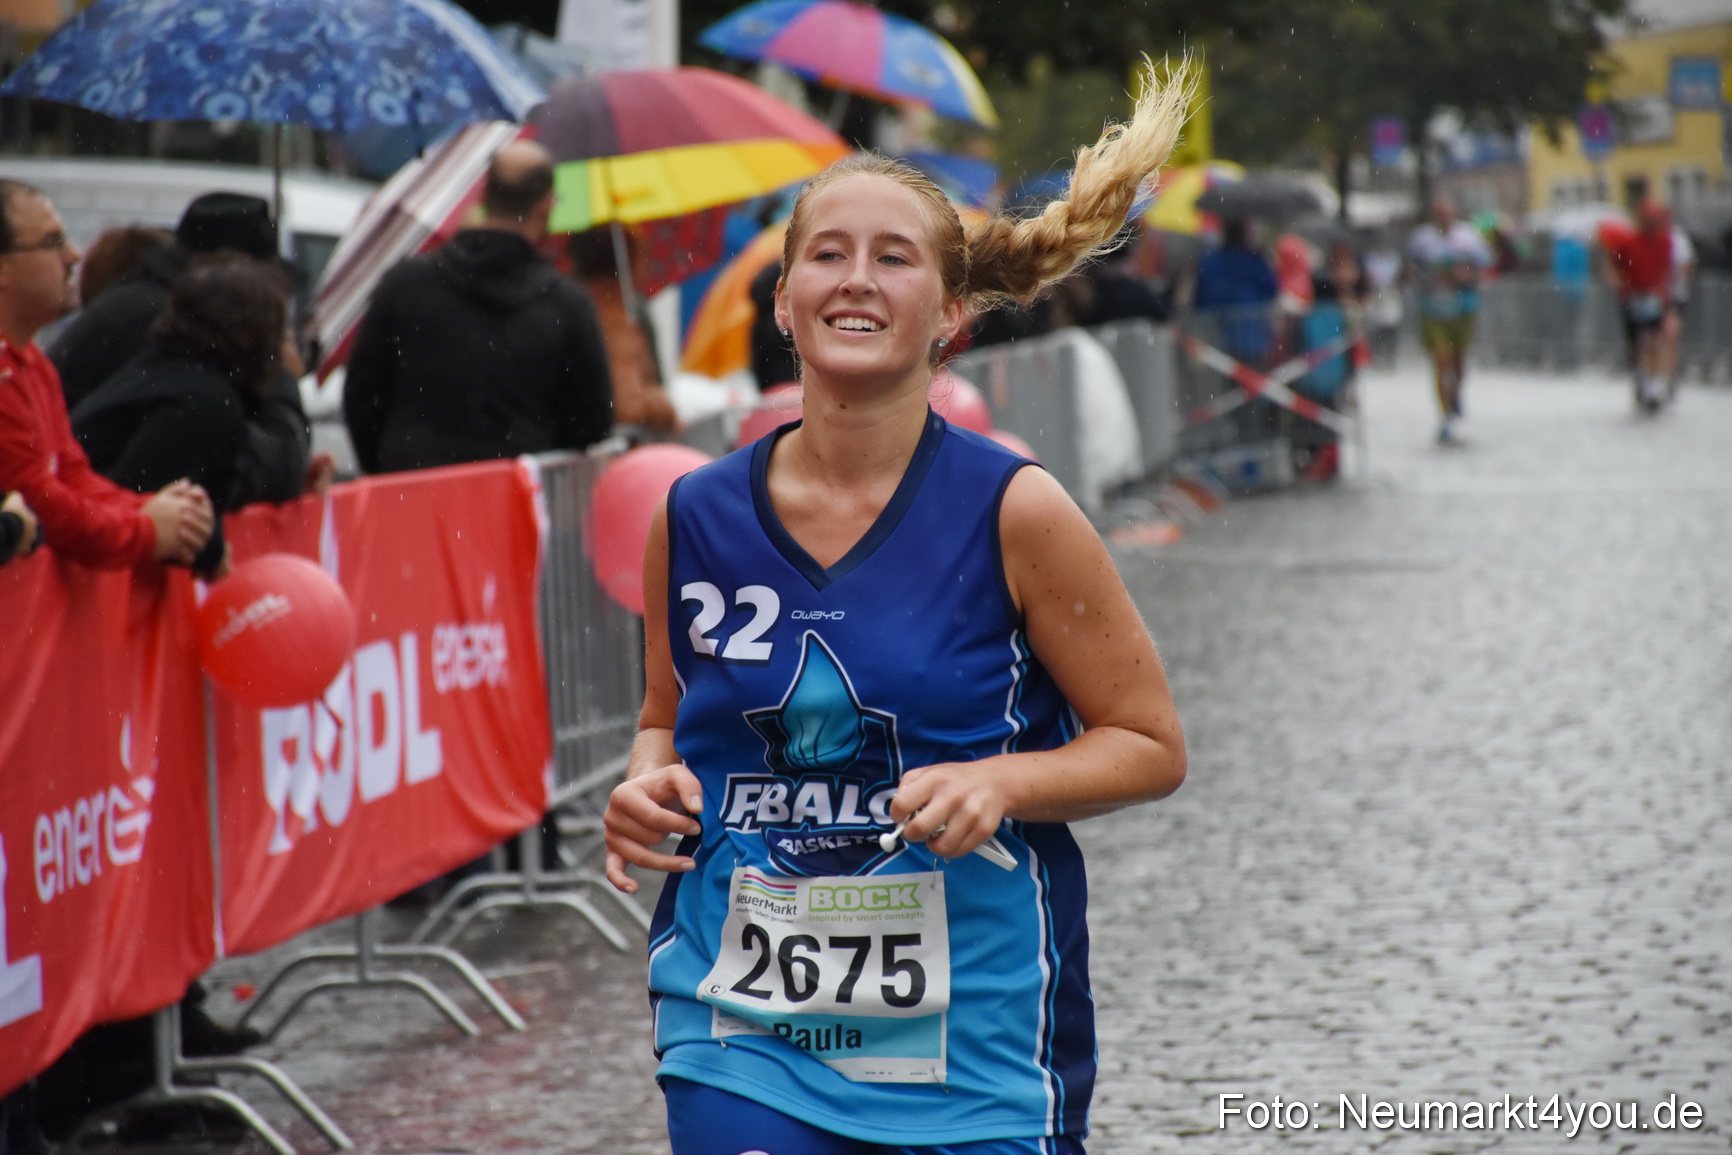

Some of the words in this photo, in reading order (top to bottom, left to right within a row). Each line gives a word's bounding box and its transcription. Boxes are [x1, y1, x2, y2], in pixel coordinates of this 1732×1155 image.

[680, 581, 781, 661] 22
[809, 914, 841, 923] inspired
[843, 914, 854, 923] by
[885, 911, 925, 922] concepts
[810, 883, 921, 911] BOCK
[729, 923, 927, 1009] 2675
